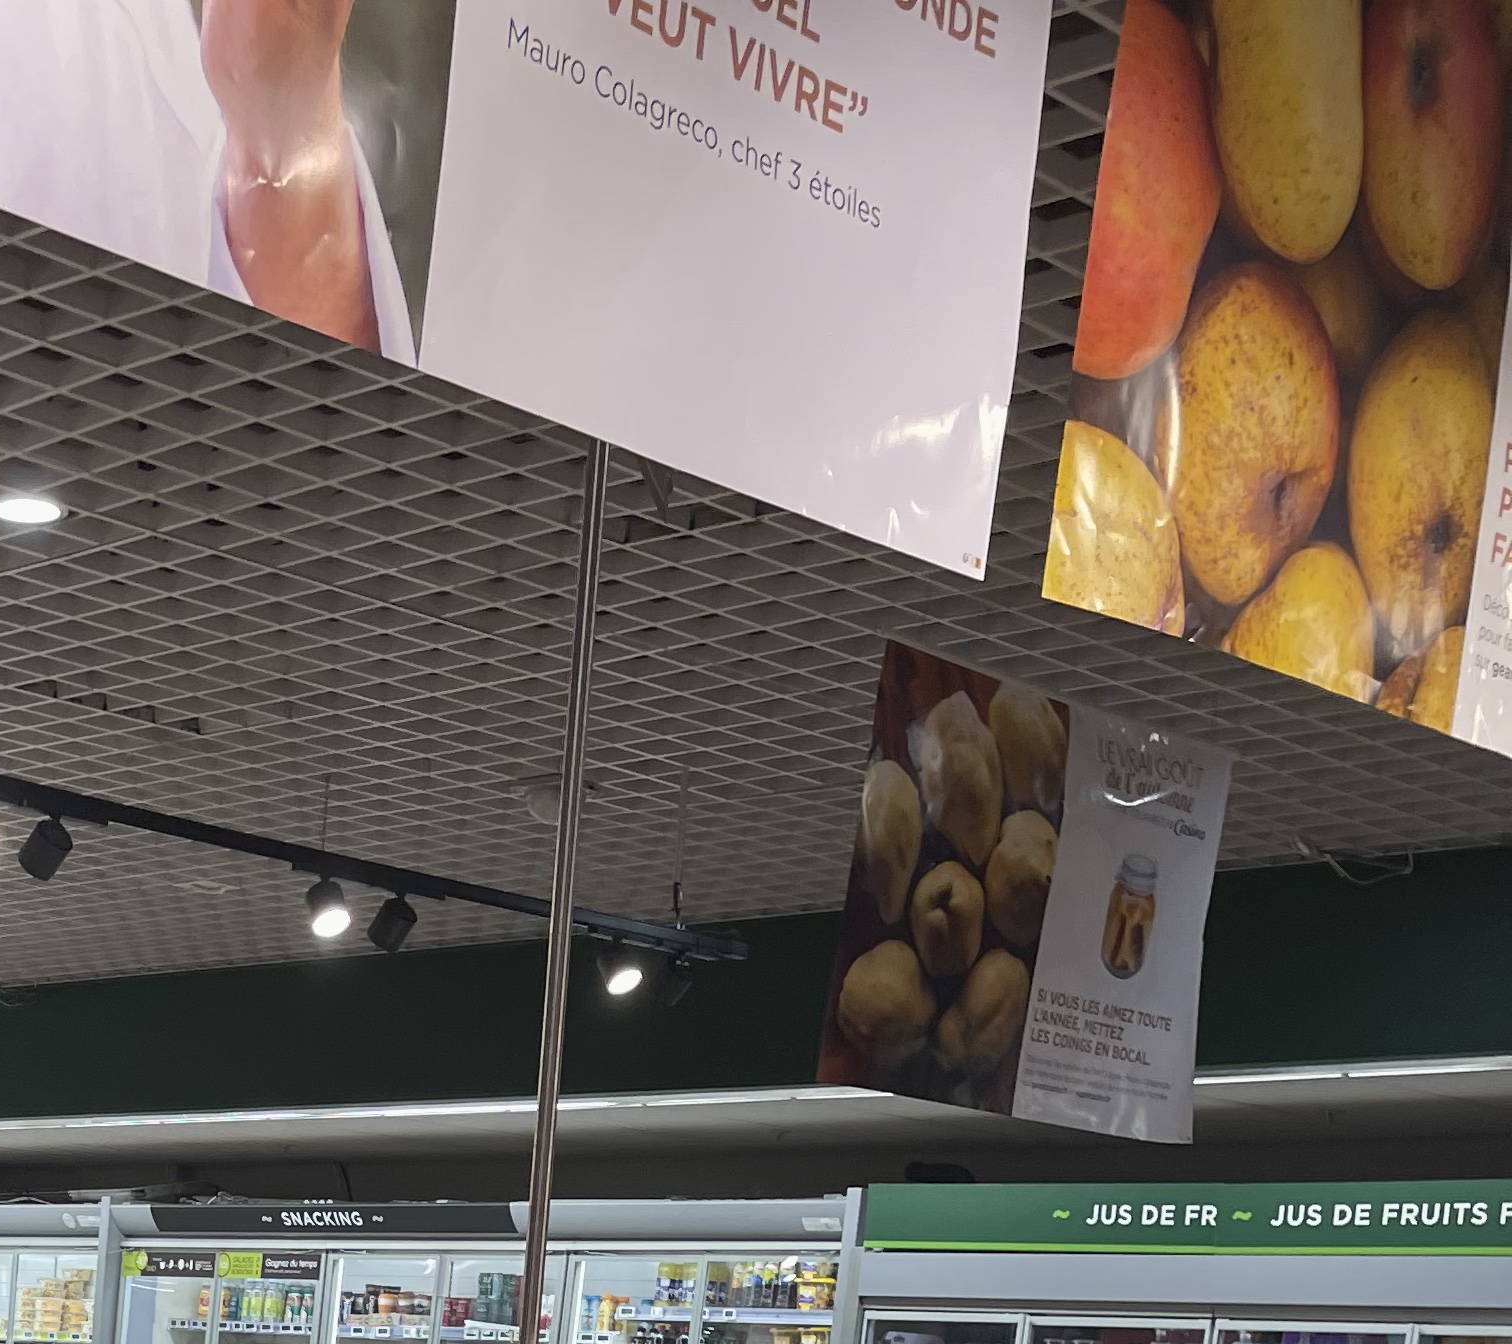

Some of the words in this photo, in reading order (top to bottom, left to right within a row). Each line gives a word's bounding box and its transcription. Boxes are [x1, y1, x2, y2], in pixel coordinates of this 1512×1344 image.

[507, 17, 586, 85] Mauro
[594, 65, 723, 158] Colagreco,
[731, 136, 783, 180] chef
[788, 158, 802, 190] 3
[809, 170, 882, 229] étoiles
[1112, 1045, 1151, 1066] BOCAL
[280, 1210, 364, 1227] SNACKING
[1085, 1204, 1133, 1227] JUS
[1140, 1204, 1175, 1226] DE
[1184, 1204, 1218, 1227] FR
[1269, 1204, 1327, 1227] JUS
[1332, 1203, 1372, 1226] DE
[1381, 1202, 1489, 1226] FRUITS
